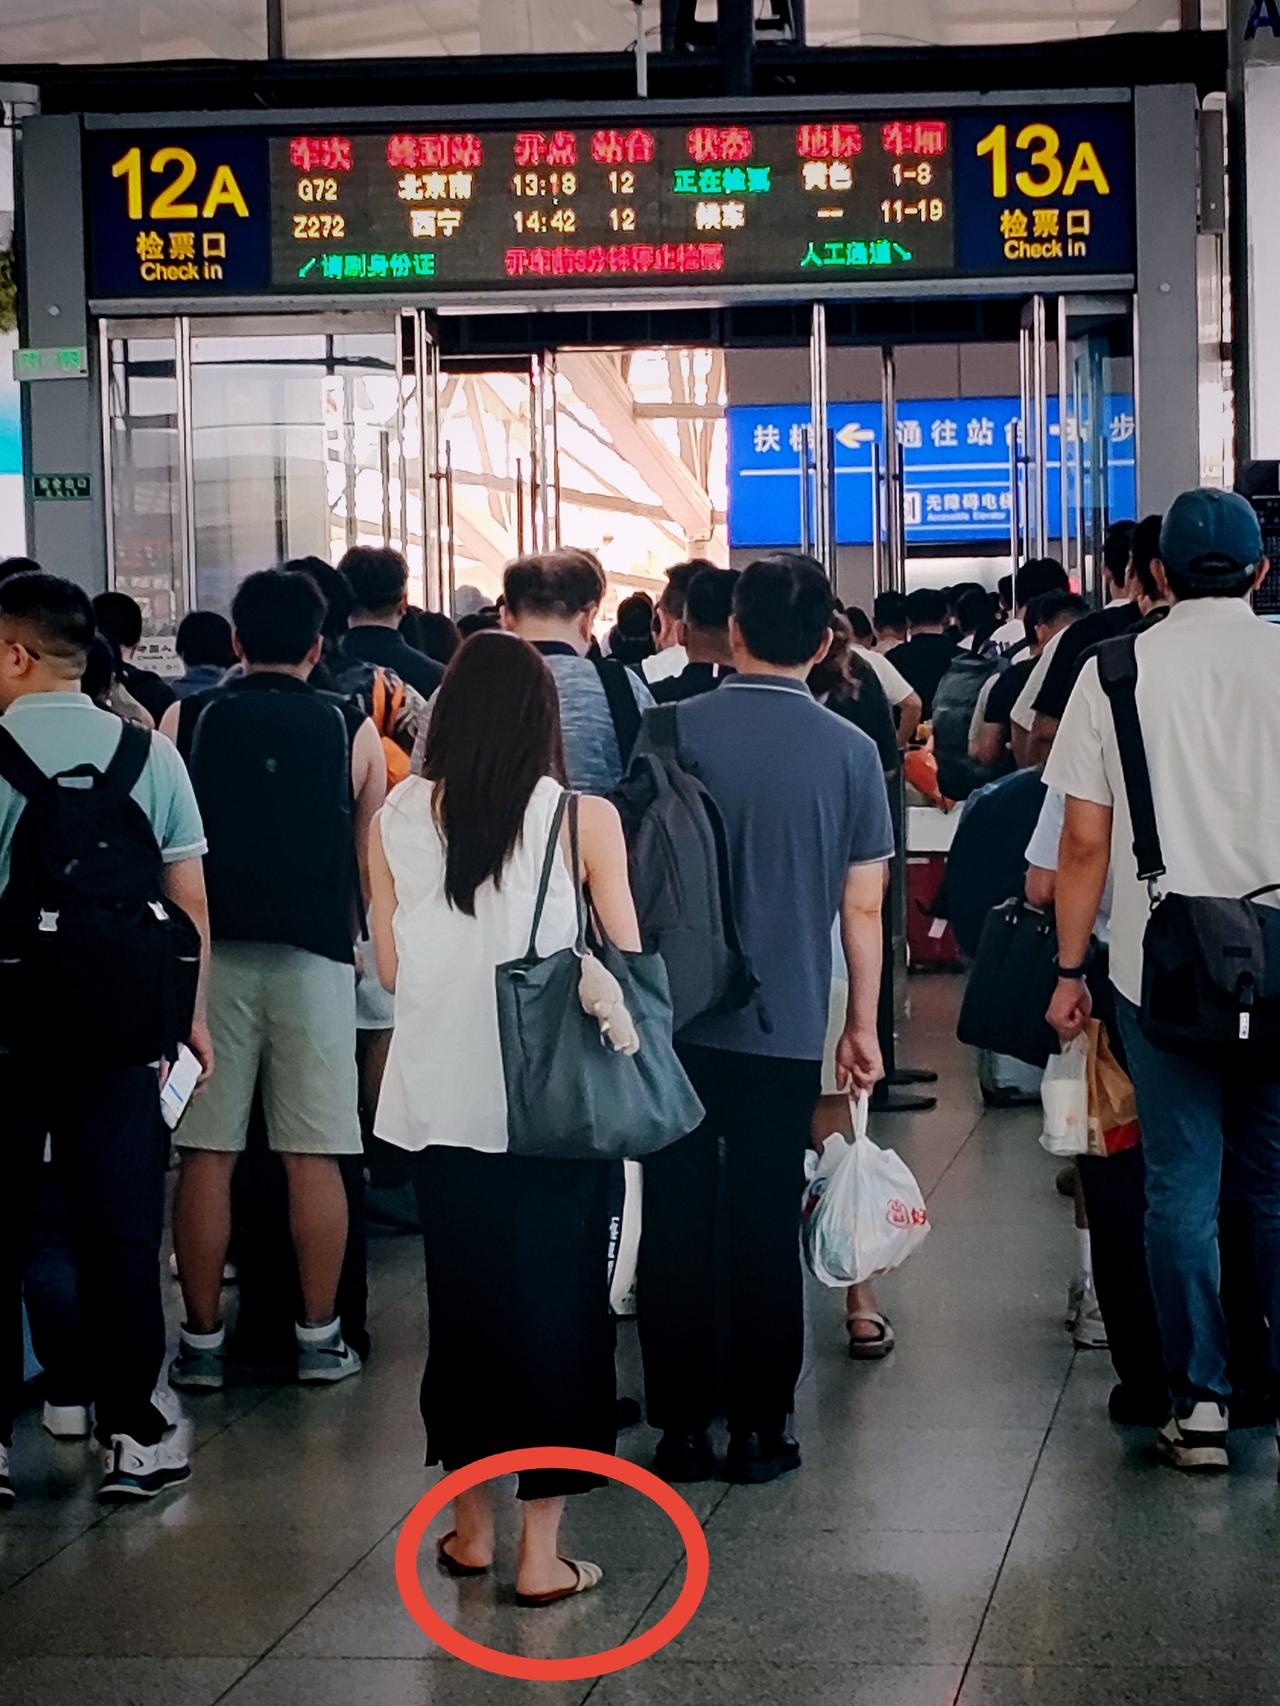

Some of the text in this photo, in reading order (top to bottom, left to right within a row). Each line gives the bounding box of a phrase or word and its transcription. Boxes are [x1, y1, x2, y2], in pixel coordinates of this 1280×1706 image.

[976, 123, 1110, 198] 13A
[112, 147, 249, 219] 12A
[298, 161, 934, 201] G72 北京南 13:18 12 正在检票 黄色 1-8
[293, 214, 346, 238] Z272
[410, 208, 462, 237] 西宁
[513, 208, 577, 233] 14:42
[609, 208, 636, 231] 12
[1000, 208, 1091, 239] 检票口
[136, 231, 226, 260] 检票口
[799, 239, 893, 267] 人工通道
[1004, 238, 1087, 260] Check in
[140, 261, 224, 281] Check in
